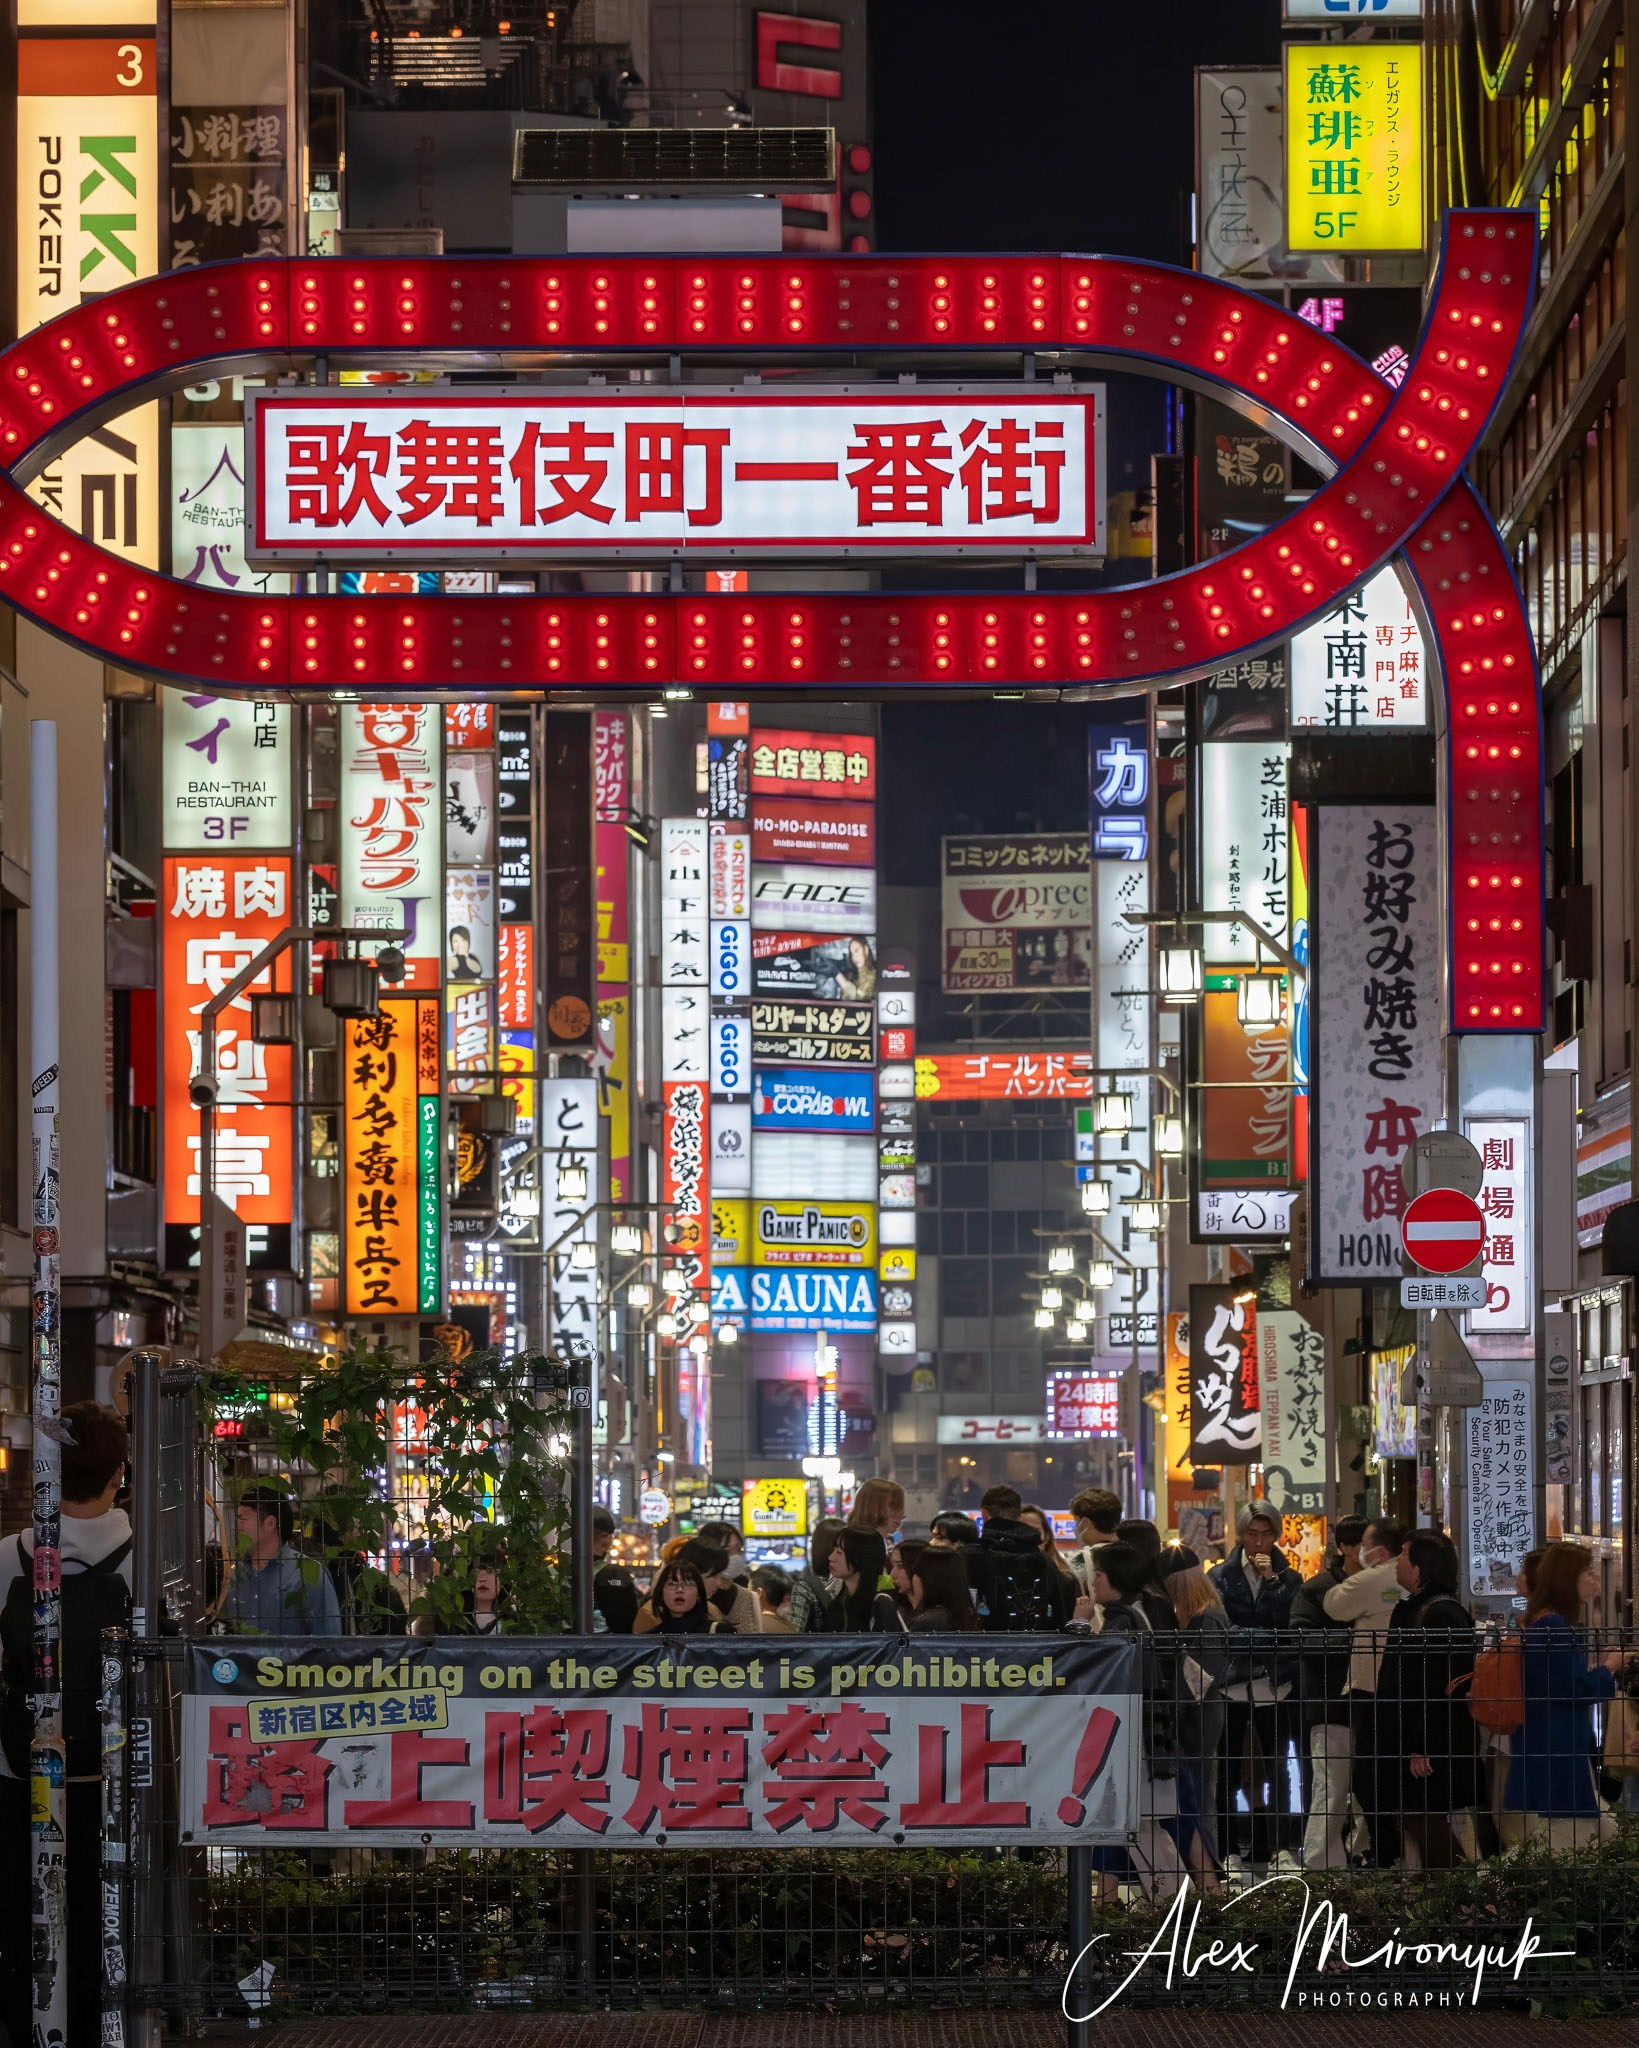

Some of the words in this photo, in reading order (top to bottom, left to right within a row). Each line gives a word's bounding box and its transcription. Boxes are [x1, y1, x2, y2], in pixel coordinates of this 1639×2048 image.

[116, 45, 144, 87] 3
[171, 112, 284, 161] 小料理
[1386, 61, 1401, 207] エレガンス・ラウンジ
[38, 136, 62, 298] POKER
[79, 135, 137, 282] KK
[1313, 211, 1358, 238] 5F
[1296, 297, 1344, 332] 4F
[285, 419, 1066, 528] 歌舞伎町一番街
[1375, 625, 1396, 718] 専門店
[752, 745, 869, 784] 全店営業中
[176, 796, 277, 808] RESTAURANT
[188, 781, 267, 793] BAN-THAI
[202, 816, 250, 840] 3F
[1260, 755, 1287, 939] 芝浦ホルモン
[170, 866, 286, 919] 焼肉
[755, 881, 871, 905] FACE
[720, 925, 738, 990] GiGO
[1362, 819, 1417, 1081] お好み焼き
[752, 1005, 871, 1035] ビリヤード&ダーツ
[720, 1023, 739, 1088] GiGO
[788, 1038, 828, 1060] ゴルフ
[33, 1071, 54, 1093] WEED
[673, 1087, 704, 1217] 横浜家系
[762, 1209, 802, 1239] GAME
[806, 1208, 848, 1240] PANIC
[1481, 1137, 1515, 1314] 劇場通り
[751, 1273, 876, 1313] SAUNA
[1407, 1284, 1480, 1303] 自転車を除く
[1264, 1325, 1278, 1383] HIROSHIMA
[1284, 1323, 1325, 1468] お好み焼き
[1482, 1398, 1492, 1415] For
[961, 1417, 1032, 1439] コーヒー
[1266, 1388, 1282, 1458] TEPPANYAKI
[1471, 1416, 1481, 1459] Security
[1482, 1419, 1493, 1444] Your
[1471, 1462, 1482, 1503] Camera
[1493, 1397, 1515, 1559] 防犯カメラ作動中
[1302, 1493, 1324, 1508] B1
[255, 1656, 465, 1698] Smorking
[479, 1664, 531, 1690] on
[547, 1658, 618, 1690] the
[632, 1658, 765, 1690] street
[779, 1657, 816, 1689] is
[830, 1656, 1067, 1696] prohibited.
[257, 1695, 439, 1737] 新宿区内全域
[202, 1702, 1121, 1836] 路上喫煙禁止!
[102, 1880, 120, 1940] ZEMOK
